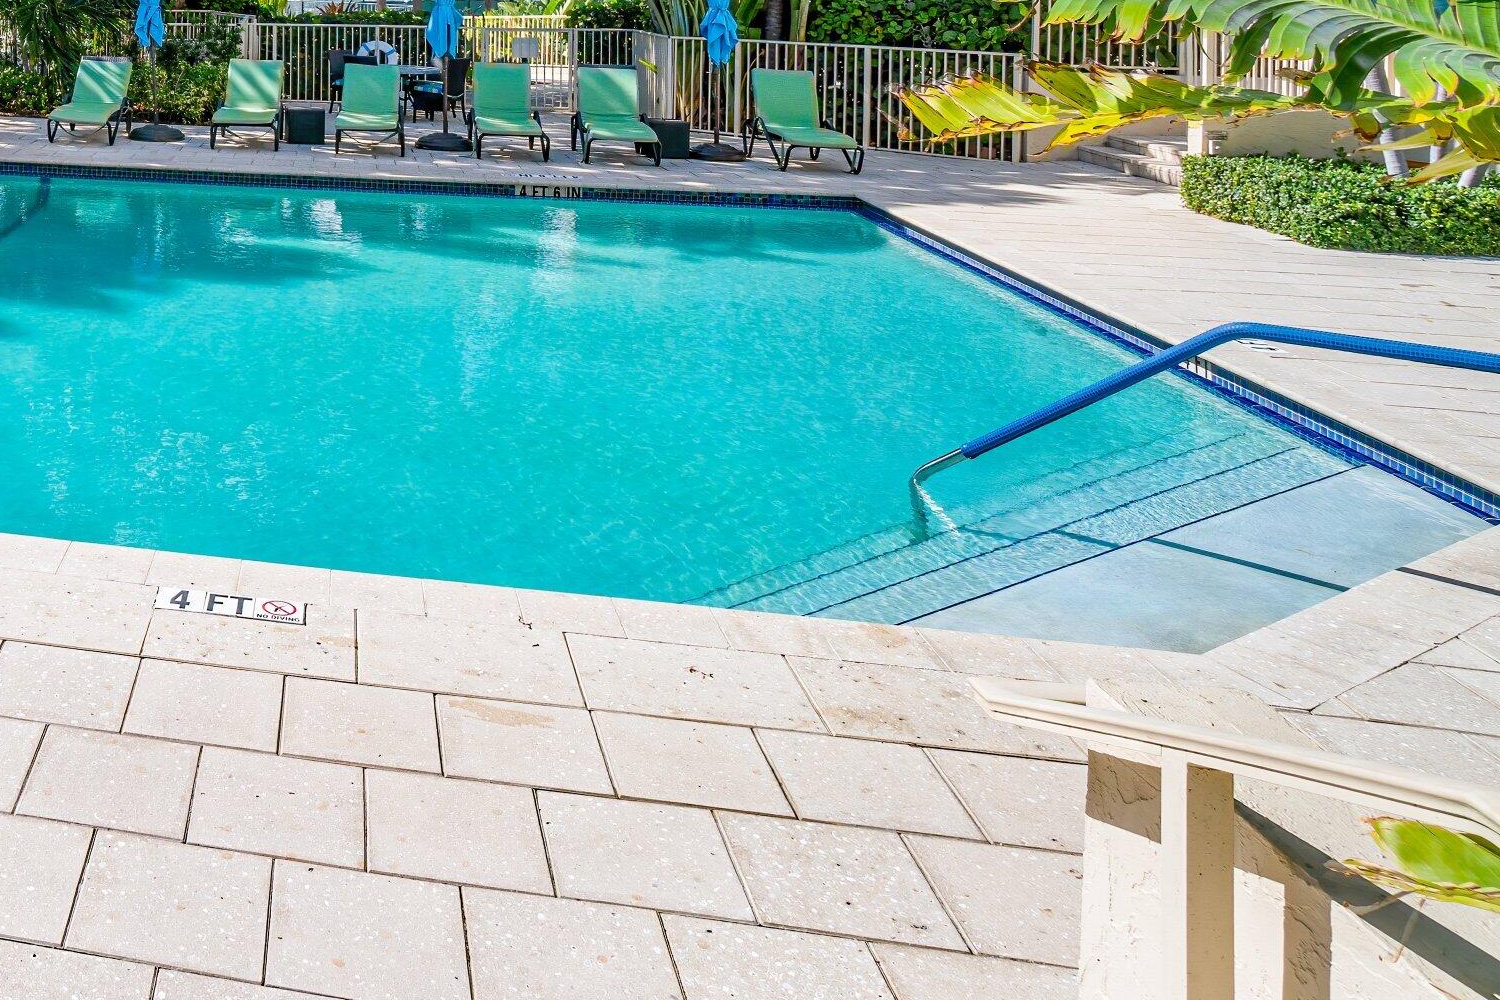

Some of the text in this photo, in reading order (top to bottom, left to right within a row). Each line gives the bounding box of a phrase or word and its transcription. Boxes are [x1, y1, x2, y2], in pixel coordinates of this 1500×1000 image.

[519, 185, 581, 198] 4 FT 6 IN
[169, 590, 253, 615] 4 FT
